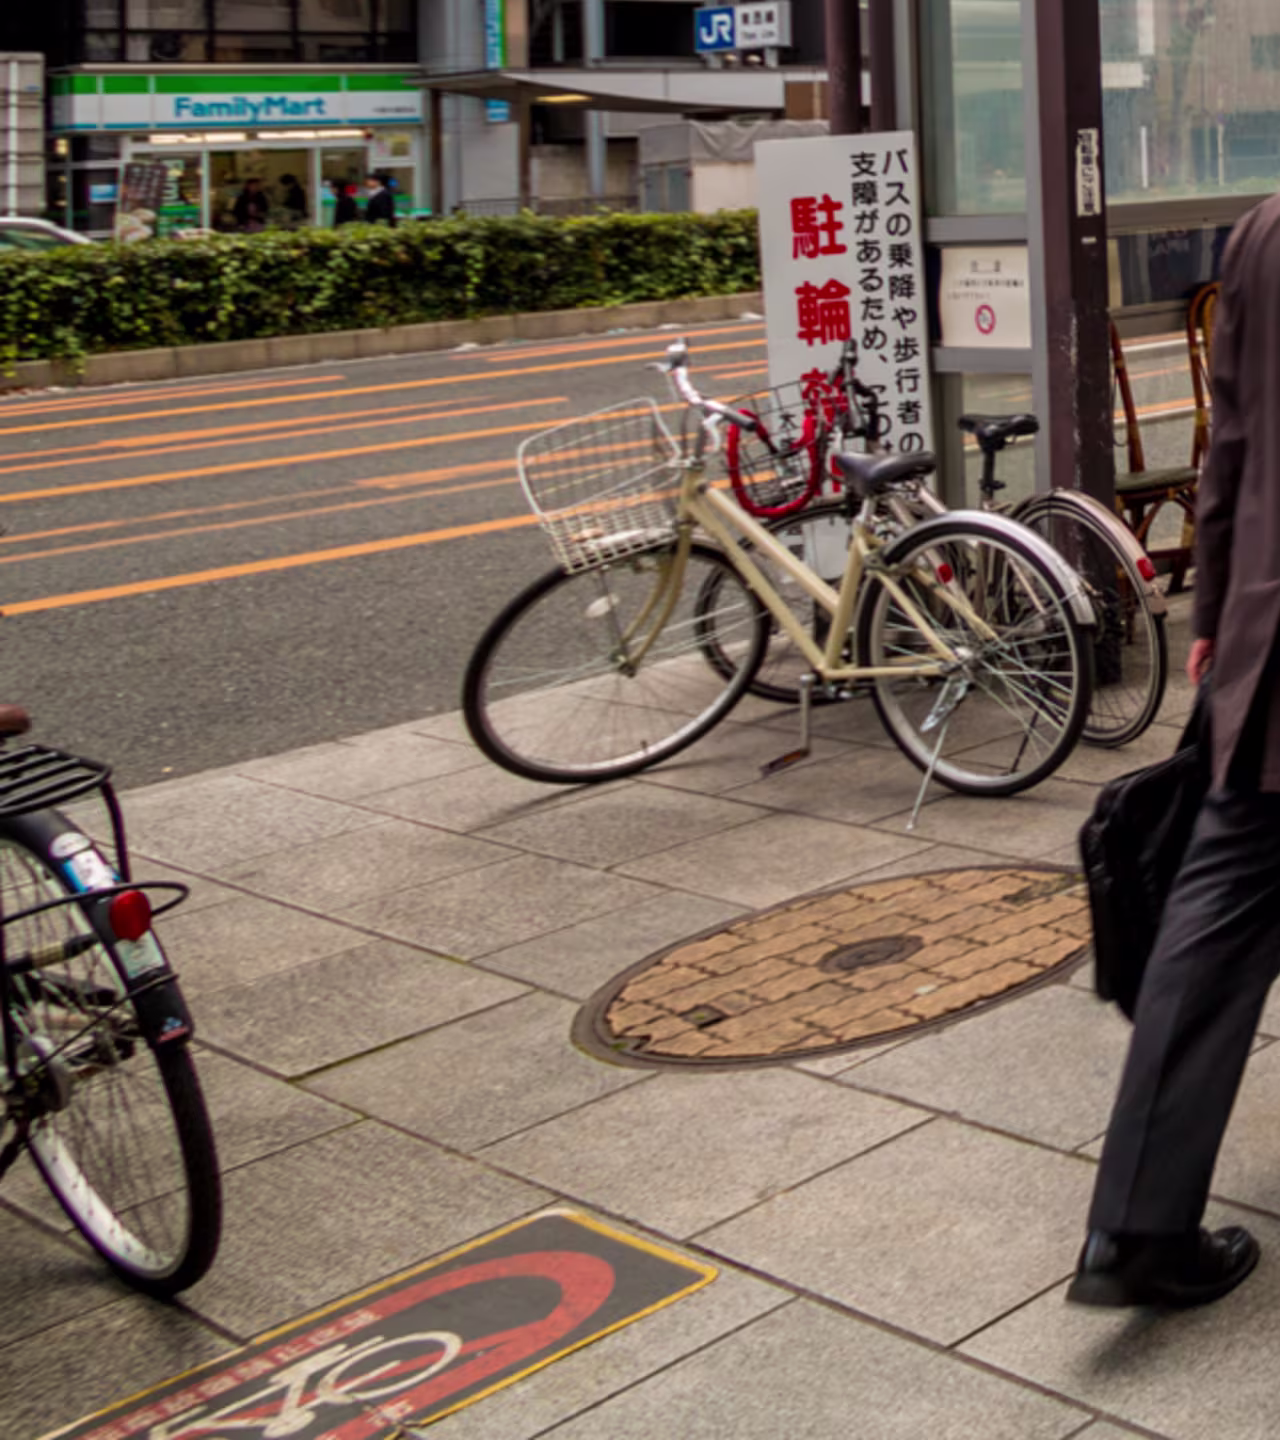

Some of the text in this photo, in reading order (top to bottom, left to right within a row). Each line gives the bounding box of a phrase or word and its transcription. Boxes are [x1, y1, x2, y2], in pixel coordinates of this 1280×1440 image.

[701, 13, 732, 45] JR
[173, 96, 326, 123] FamilyMart
[850, 151, 894, 453] 支障があるため、この
